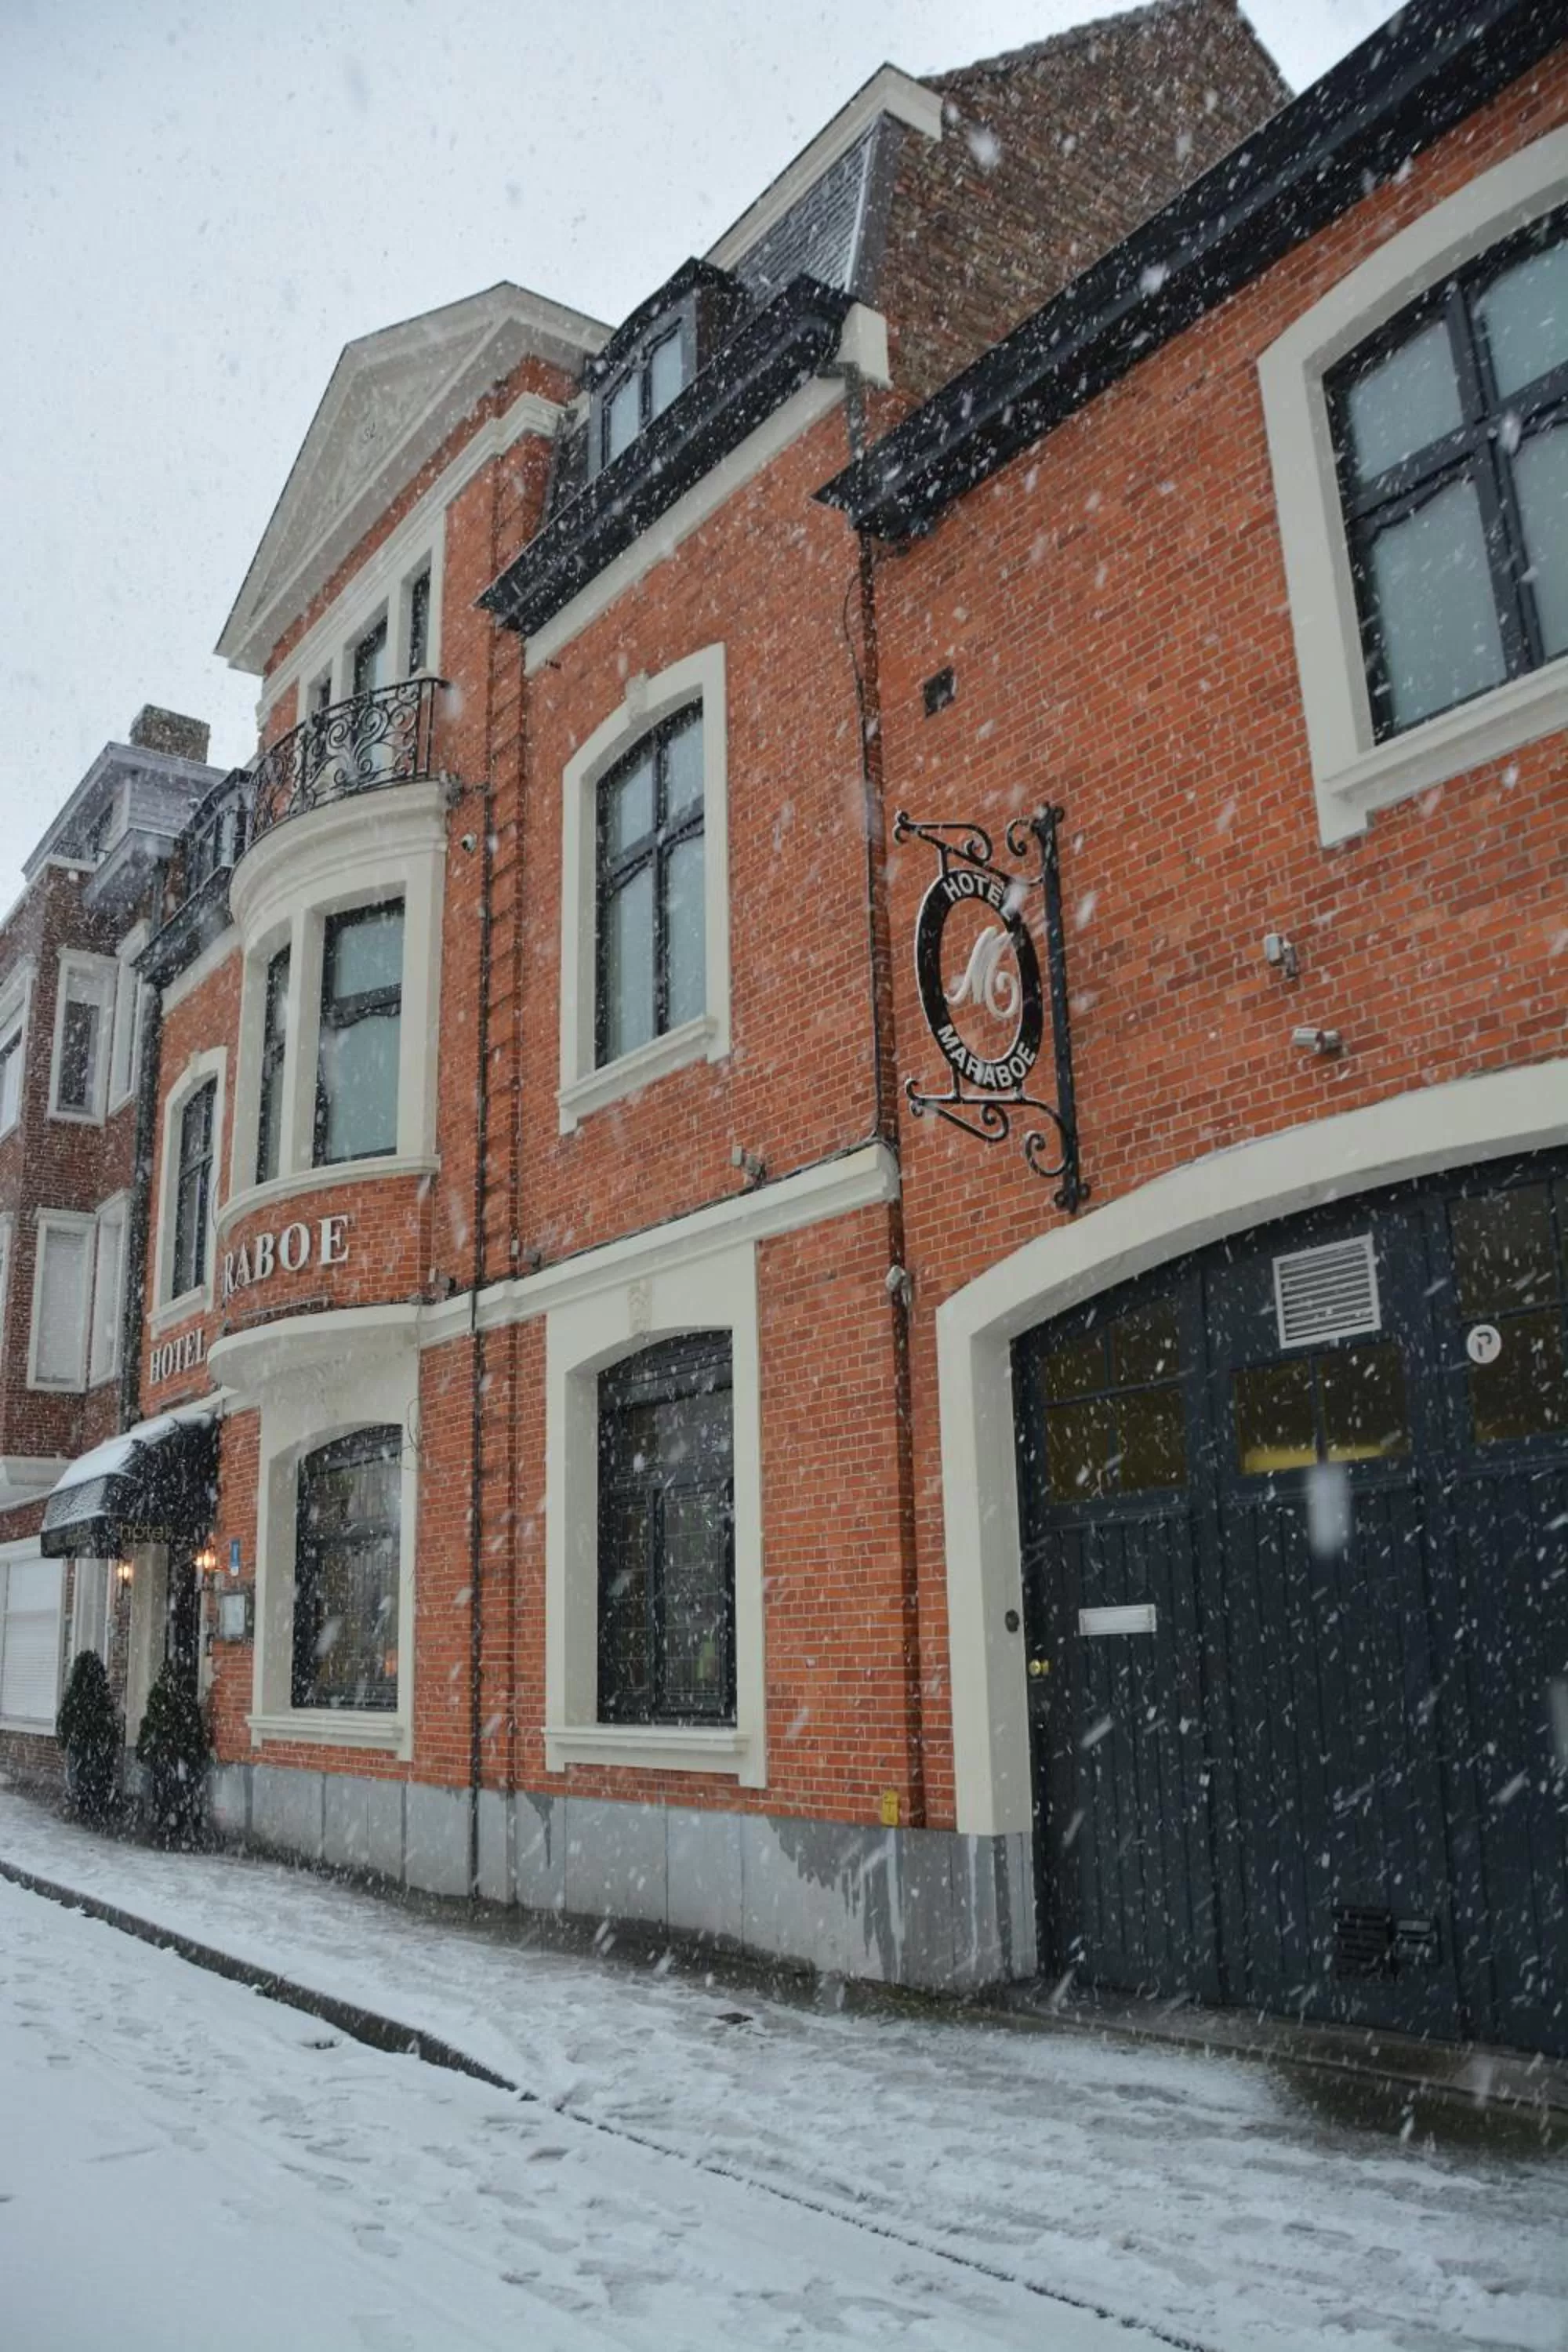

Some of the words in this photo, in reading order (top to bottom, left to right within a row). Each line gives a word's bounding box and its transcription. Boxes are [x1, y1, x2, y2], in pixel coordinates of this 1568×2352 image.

[938, 1023, 1036, 1087] MARABOE
[224, 1214, 350, 1297] RABOE
[150, 1327, 205, 1385] HOTEL
